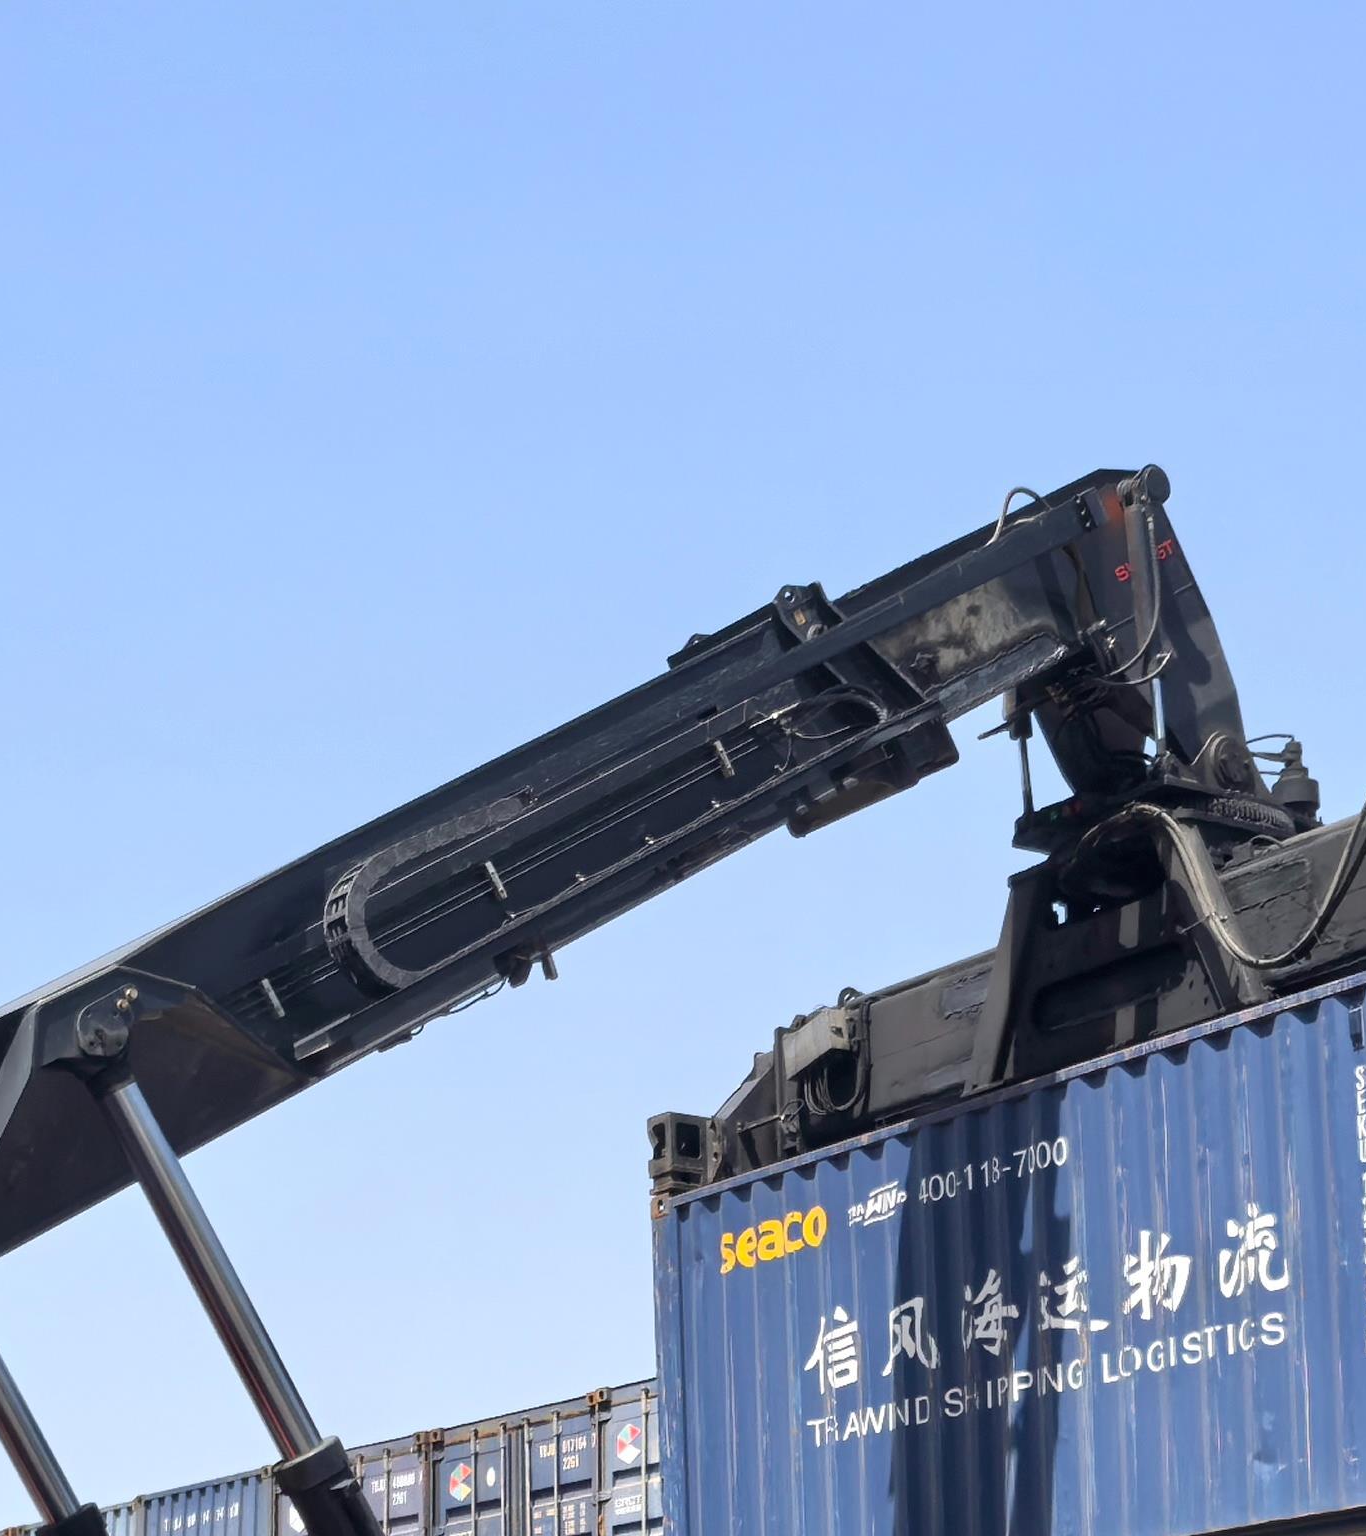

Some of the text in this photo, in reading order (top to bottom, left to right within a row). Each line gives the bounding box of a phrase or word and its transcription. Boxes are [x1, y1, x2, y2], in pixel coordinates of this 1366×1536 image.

[918, 1137, 1068, 1205] 400-118-7000
[720, 1205, 827, 1275] seaco
[804, 1202, 1290, 1396] 信风海运物流
[806, 1312, 1286, 1448] TRAWIND SHIPPING LOGISTICS
